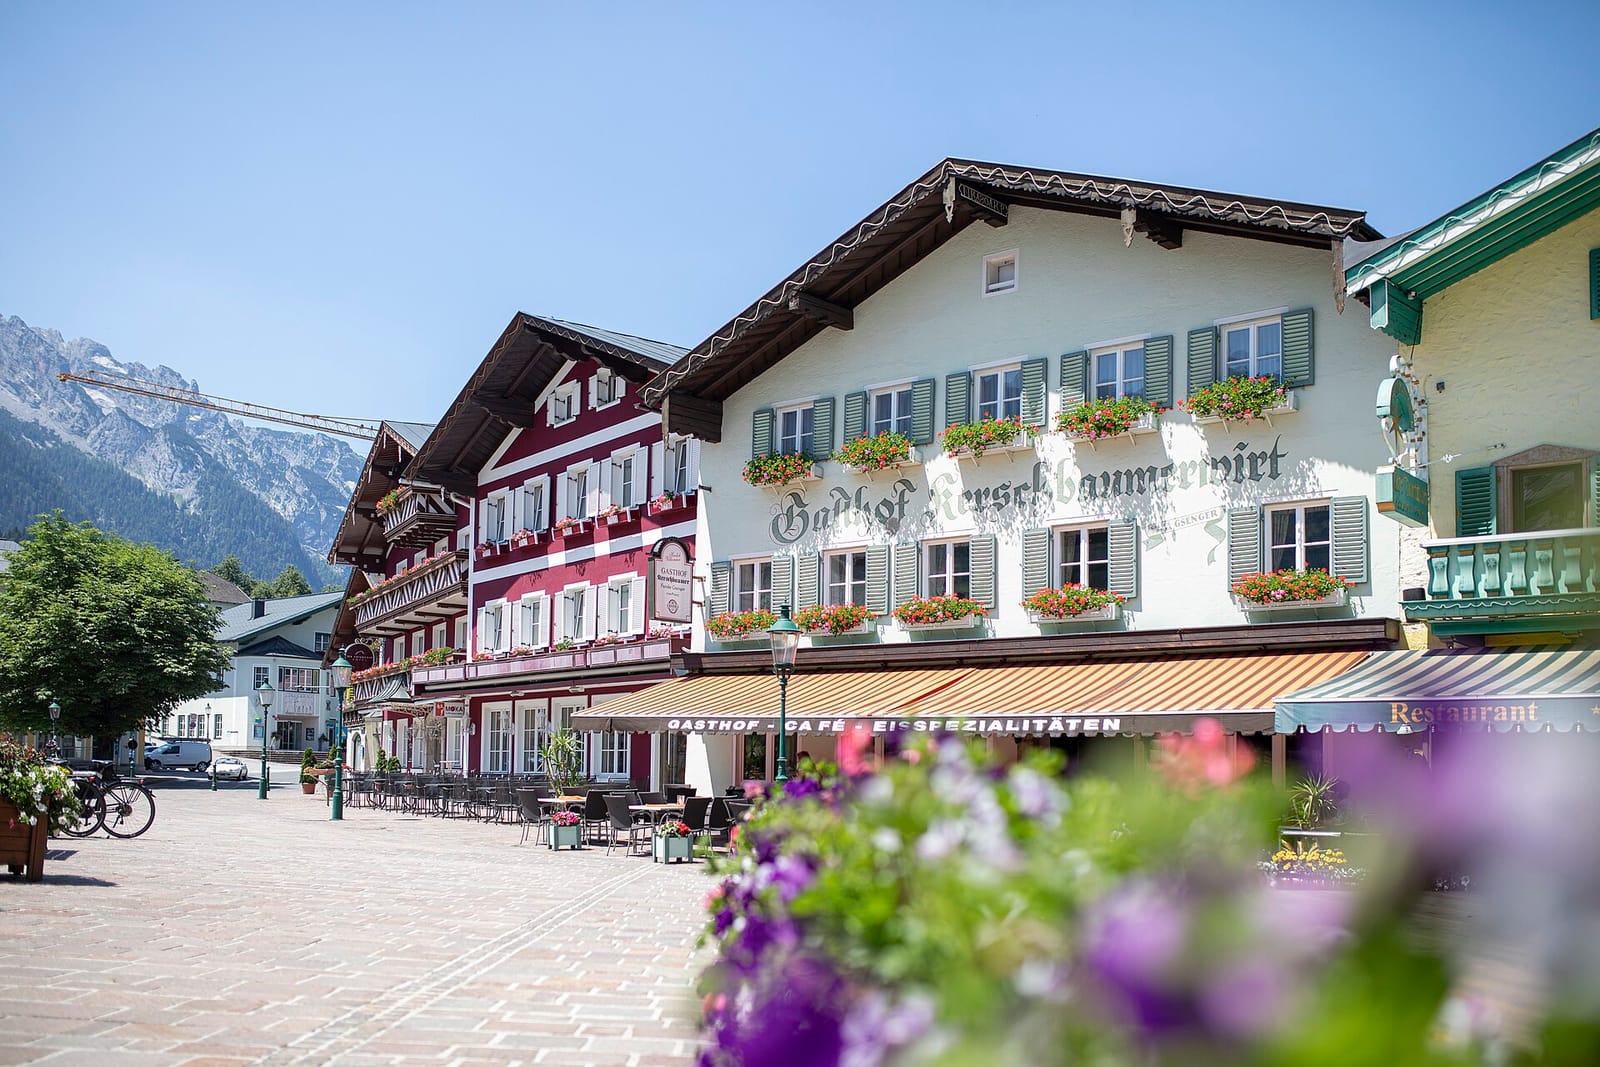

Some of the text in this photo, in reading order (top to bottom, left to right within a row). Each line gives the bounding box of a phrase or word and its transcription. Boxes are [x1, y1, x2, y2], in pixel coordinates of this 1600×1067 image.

[1174, 509, 1219, 528] GSENGER
[661, 567, 688, 578] GASTHOF
[1389, 701, 1539, 724] Restaurant
[667, 719, 760, 731] GASTHOF
[784, 718, 846, 732] CAFÉ
[873, 717, 1121, 732] EISSPEZIALITÄTEN
